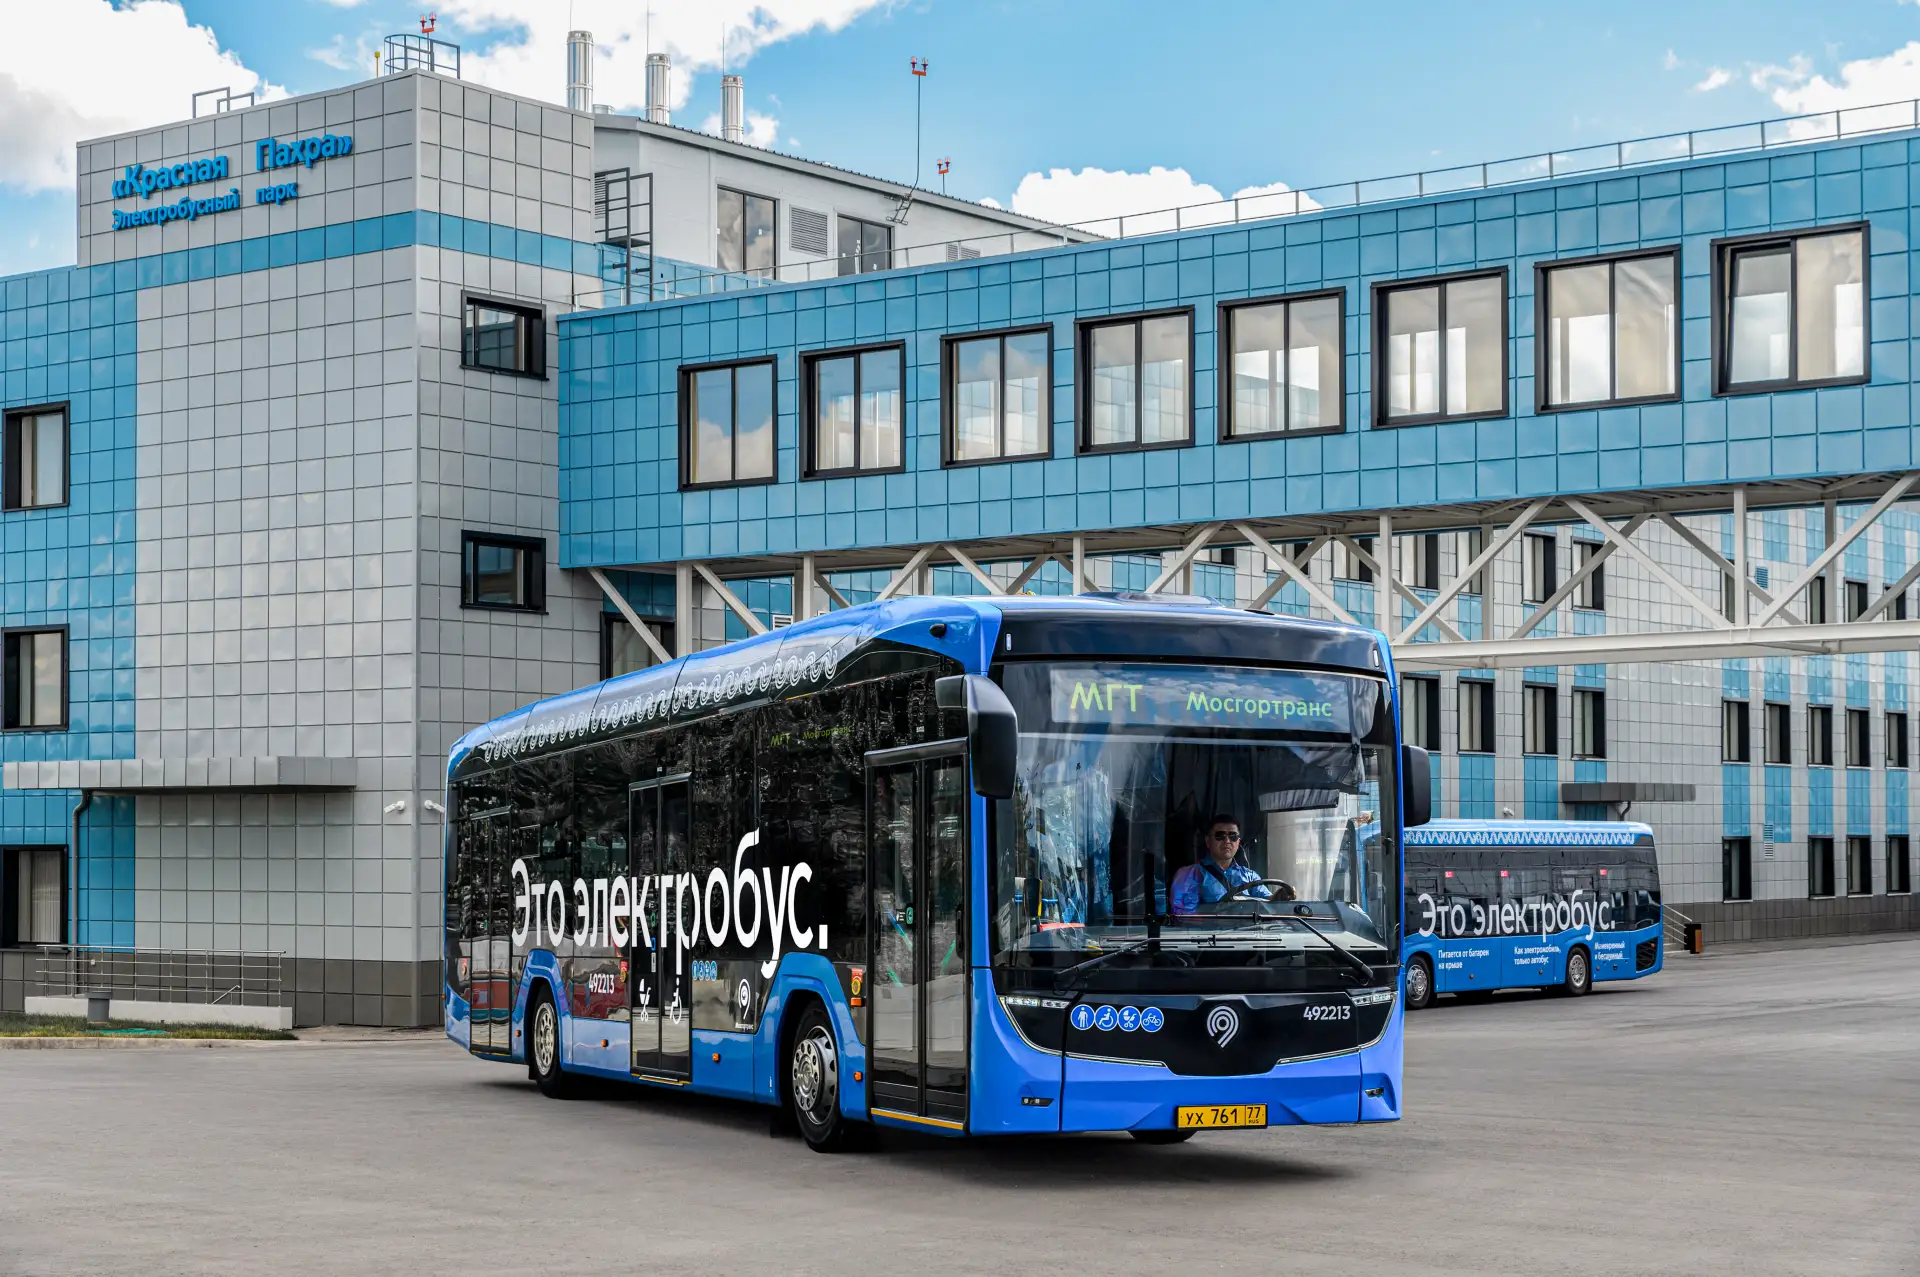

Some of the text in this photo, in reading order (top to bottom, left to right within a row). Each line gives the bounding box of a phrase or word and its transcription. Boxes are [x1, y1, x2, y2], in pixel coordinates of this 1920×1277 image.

[112, 133, 353, 199] «Красная Пахра»
[112, 181, 298, 230] Электробусный парк
[1070, 681, 1332, 720] МГТ Мосгортранс
[511, 828, 829, 979] Это электробус.
[1417, 889, 1616, 942] Это электробус.
[1438, 949, 1461, 959] Питается
[1468, 948, 1489, 958] батареи
[1514, 946, 1523, 954] Как
[1445, 961, 1462, 970] крыше
[1531, 956, 1549, 965] автобус
[589, 972, 615, 995] 492213
[1303, 1004, 1351, 1022] 492213
[1211, 1108, 1238, 1124] 761
[1247, 1106, 1261, 1118] 77
